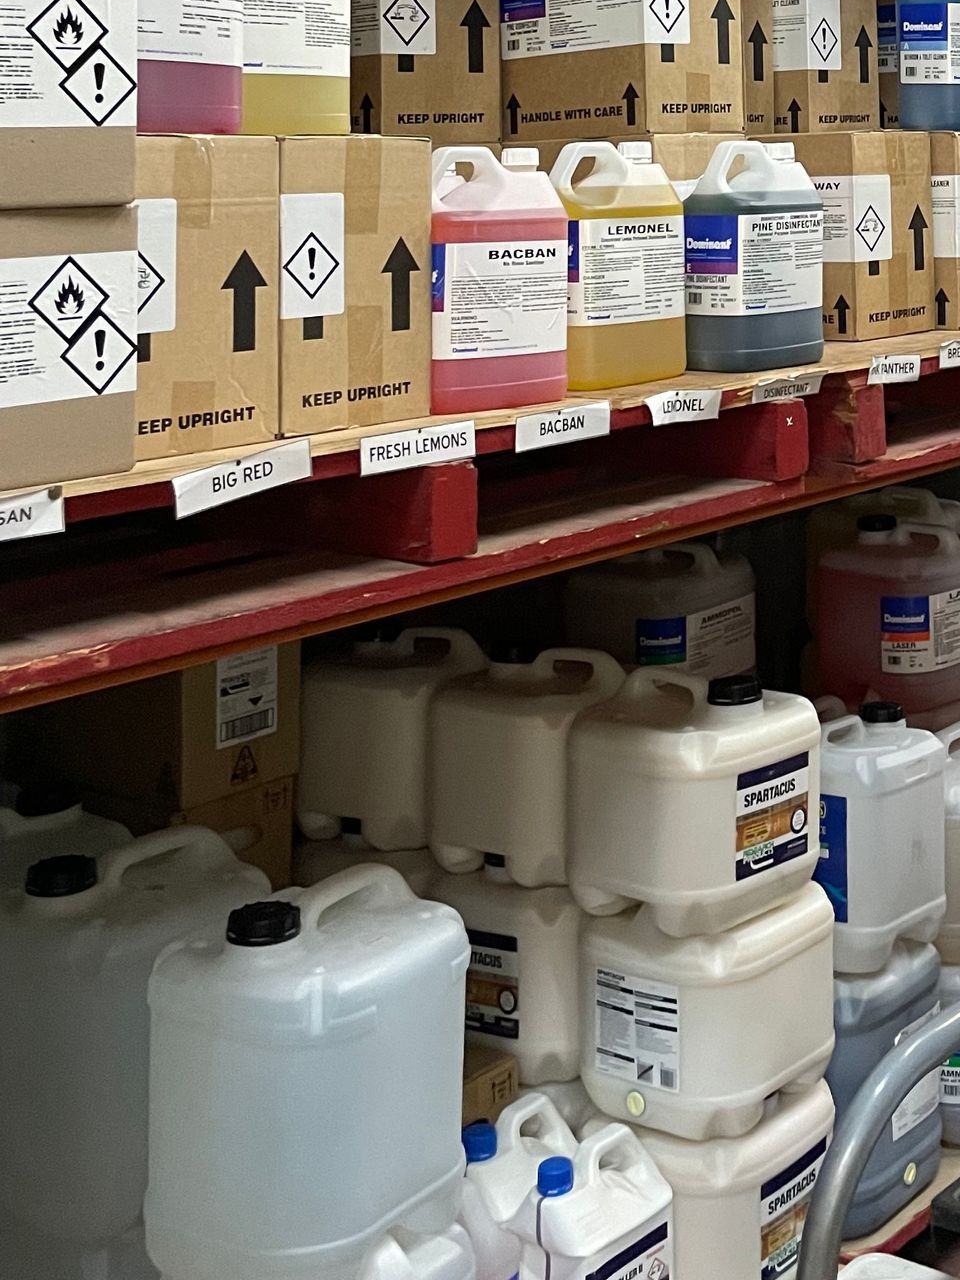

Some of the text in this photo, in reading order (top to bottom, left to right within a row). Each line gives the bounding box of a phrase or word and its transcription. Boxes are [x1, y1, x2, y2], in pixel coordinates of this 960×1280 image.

[903, 21, 944, 32] Dominant
[903, 42, 910, 51] A
[521, 105, 624, 124] HANDLE WITH CARE
[661, 103, 733, 114] KEEP UPRIGHT
[397, 112, 485, 125] KEEP UPRIGHT
[818, 114, 871, 124] KEEP UPRIGHT
[607, 222, 674, 236] LEMONEL
[752, 218, 823, 232] PINE DISINFECTAN
[686, 237, 733, 251] Dominant
[488, 247, 557, 261] BACBAN
[868, 305, 927, 323] KEEP UPRIGHT
[301, 381, 412, 409] KEEP UPRIGHT
[763, 382, 811, 400] DISINFECTANT
[662, 397, 706, 415] LEMONEL
[178, 406, 256, 430] UPRIGHT
[539, 414, 586, 436] BACBAN
[369, 432, 468, 462] FRESH LEMONS
[212, 460, 274, 493] BIG RED
[743, 777, 796, 809] SPARTACUS
[767, 1167, 817, 1216] SPARTACUS
